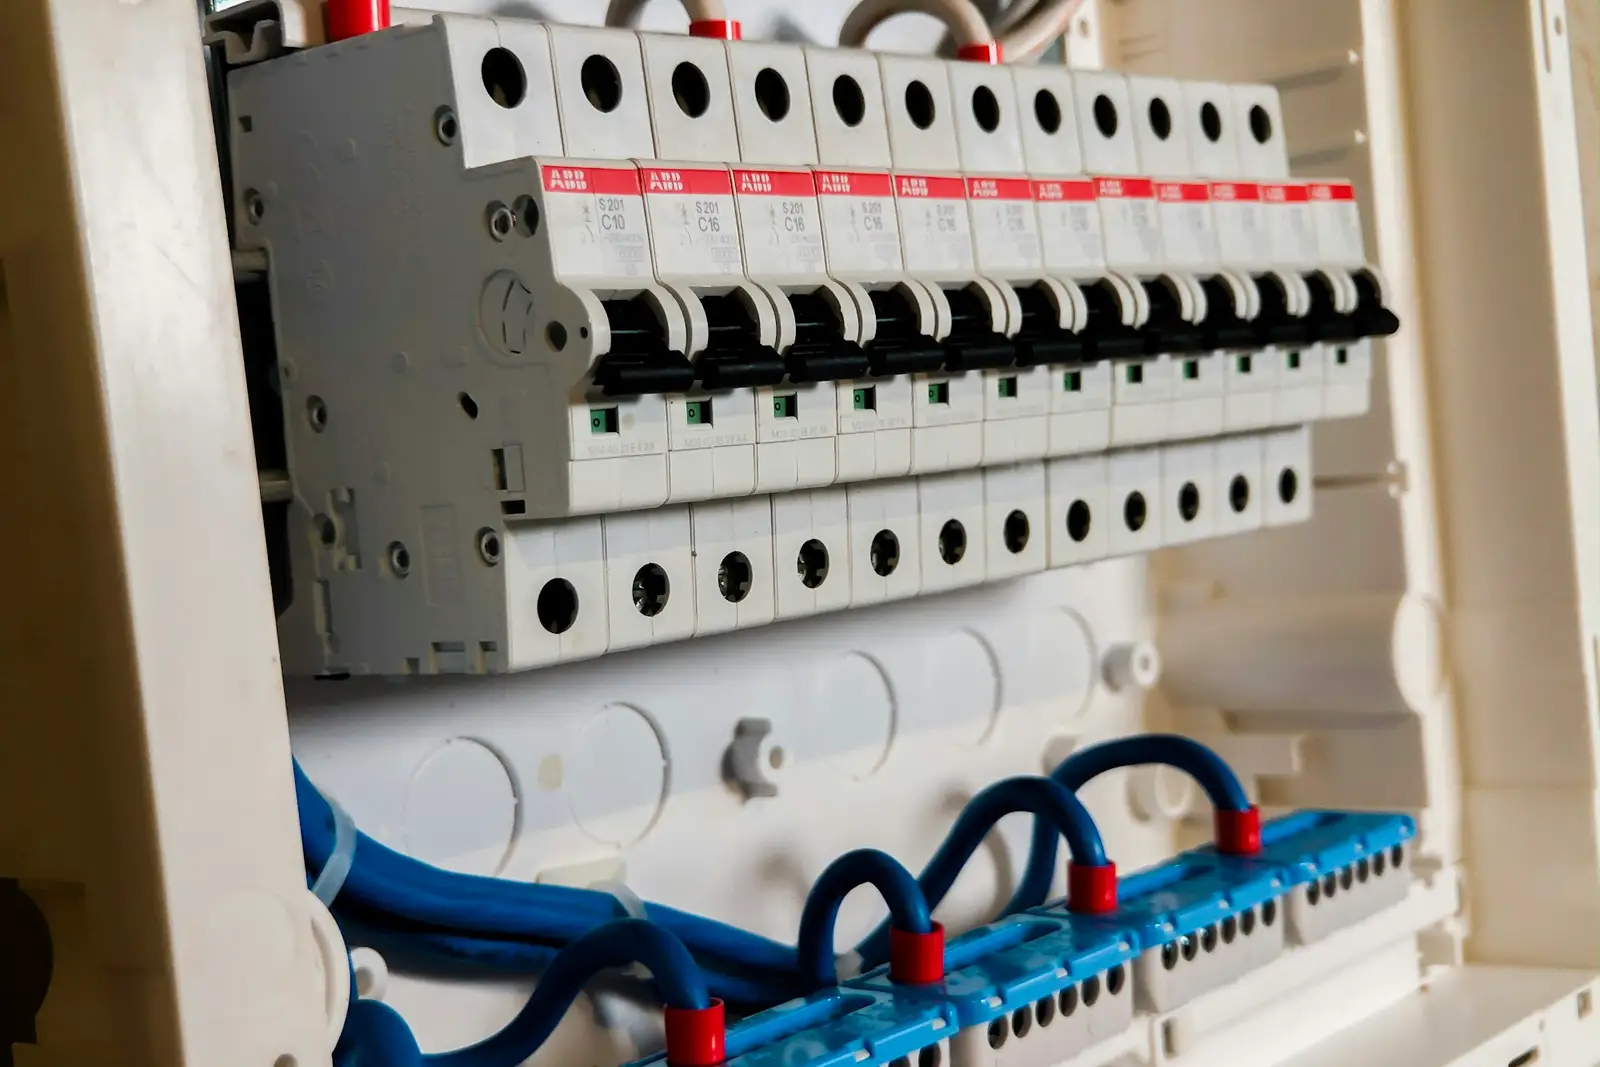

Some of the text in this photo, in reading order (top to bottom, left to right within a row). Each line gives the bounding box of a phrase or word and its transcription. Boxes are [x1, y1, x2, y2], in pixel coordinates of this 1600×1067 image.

[550, 169, 587, 190] ABB
[650, 171, 683, 191] ABB
[741, 173, 772, 192] ABB
[822, 173, 850, 193] ABB
[902, 178, 929, 196] ABB
[973, 180, 998, 197] ABB
[601, 214, 626, 231] C10
[699, 217, 720, 233] C16
[784, 217, 805, 233] C16
[864, 217, 883, 231] C16
